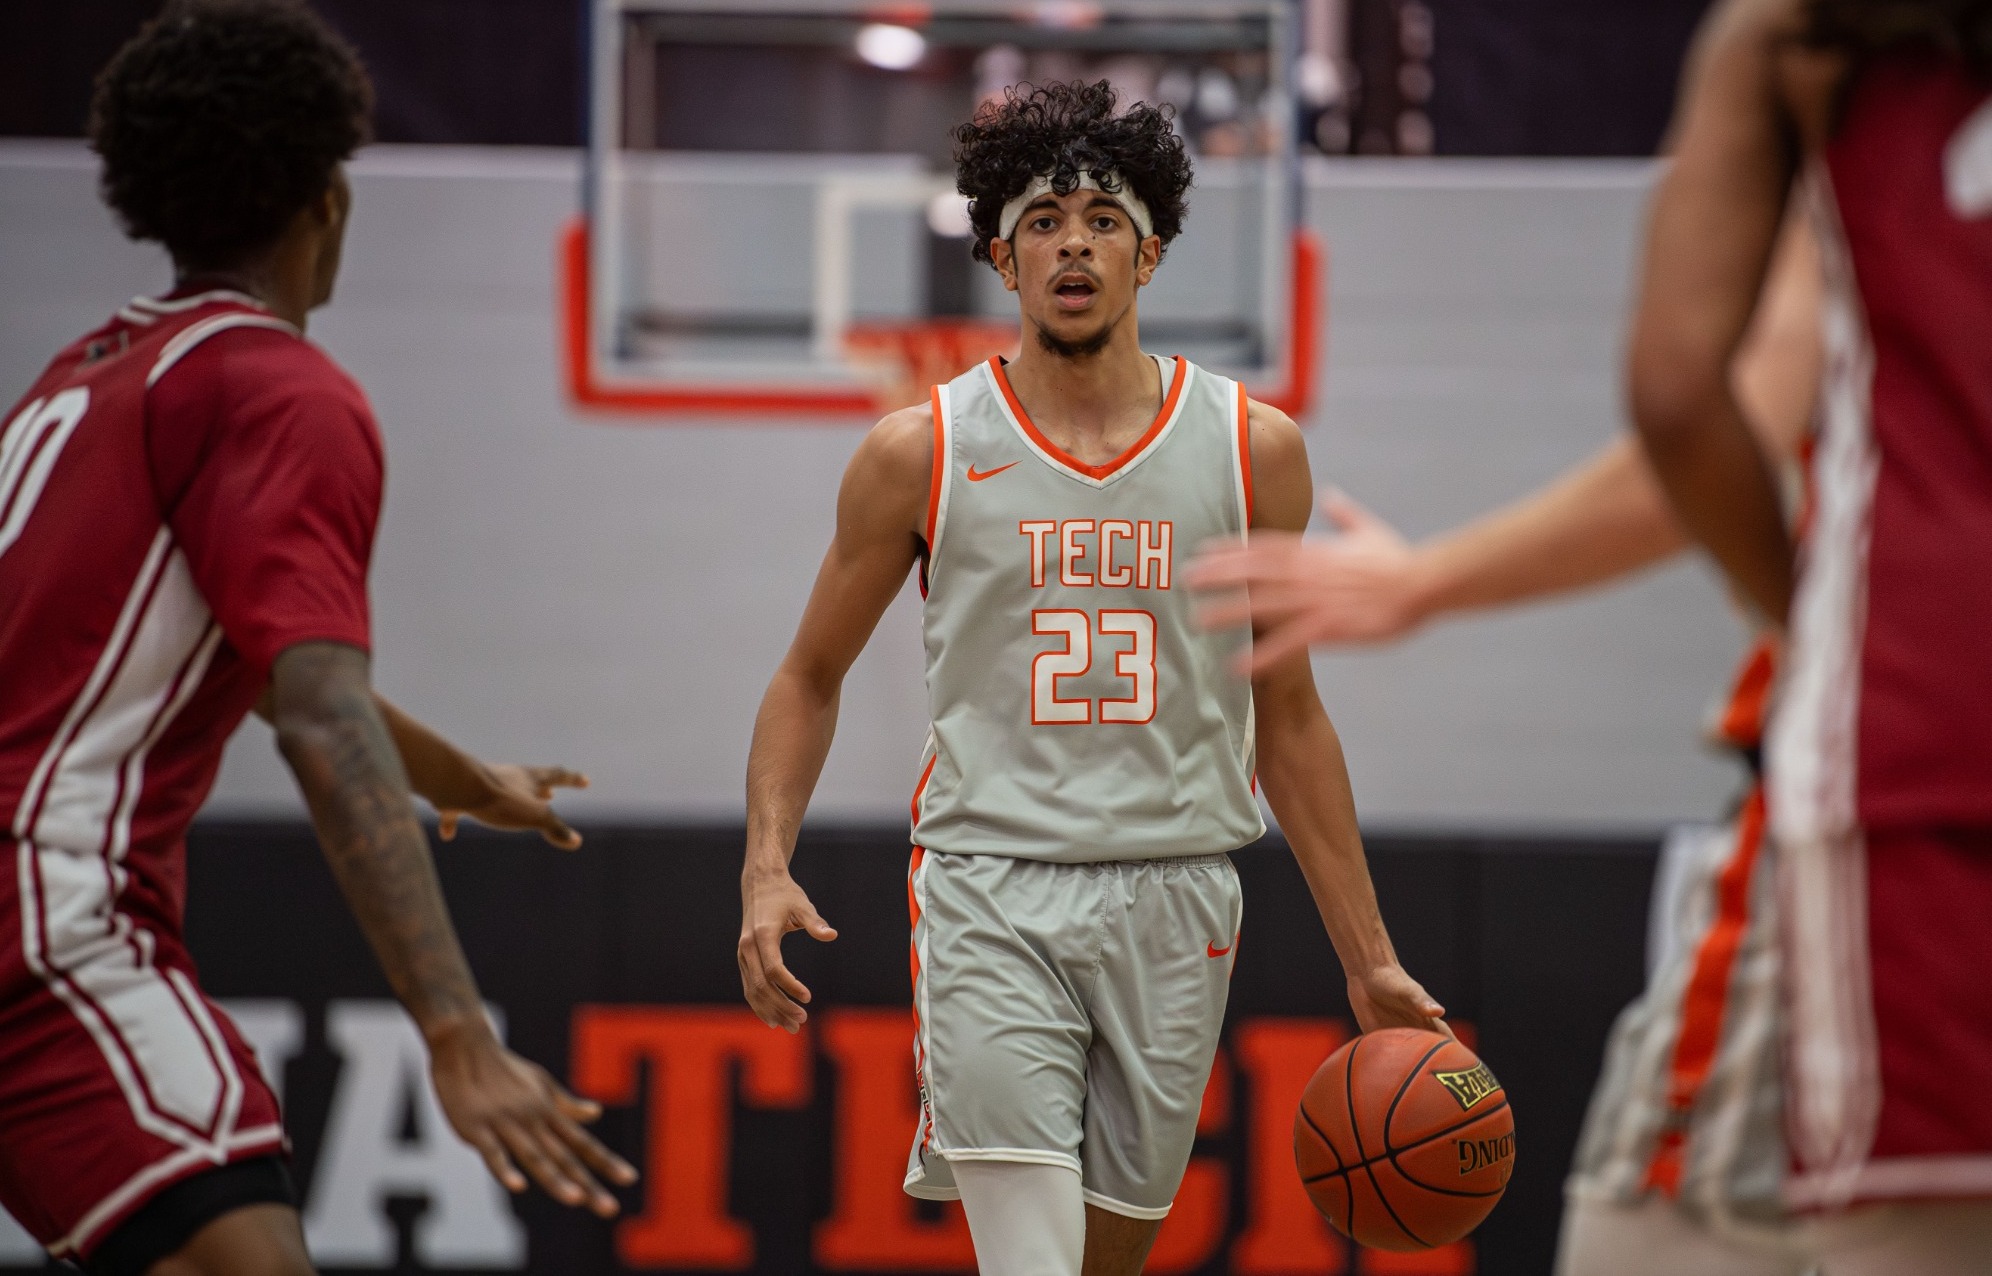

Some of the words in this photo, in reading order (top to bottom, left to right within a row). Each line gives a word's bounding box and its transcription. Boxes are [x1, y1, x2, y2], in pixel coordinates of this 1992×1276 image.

[1019, 518, 1173, 590] TECH
[1031, 608, 1157, 725] 23
[1458, 1131, 1515, 1175] LDING
